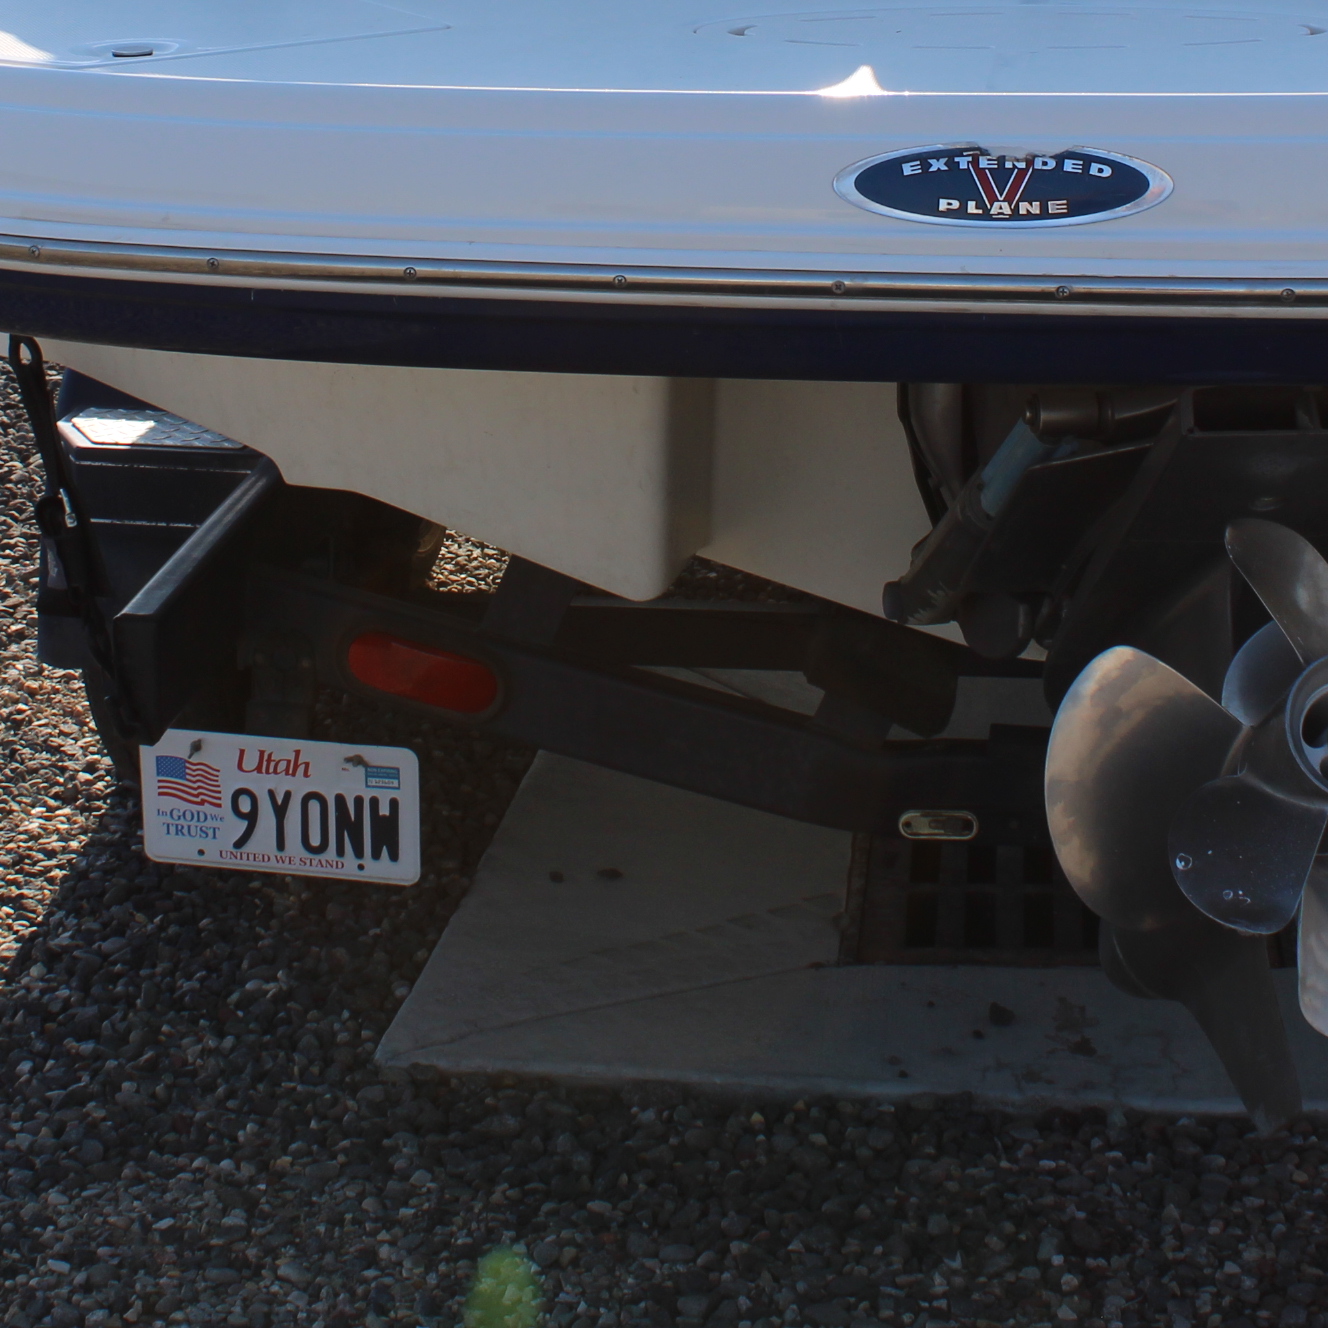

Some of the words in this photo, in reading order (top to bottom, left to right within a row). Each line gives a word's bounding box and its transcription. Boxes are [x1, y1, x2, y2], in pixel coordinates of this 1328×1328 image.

[901, 155, 1113, 179] EXTENDED
[938, 198, 1070, 216] PLANE
[236, 748, 312, 779] Utah
[156, 808, 168, 817] In
[169, 807, 209, 824] GOD
[209, 813, 225, 823] We
[162, 822, 221, 840] TRUST
[219, 849, 271, 864] UNITED
[274, 853, 297, 867] WE
[299, 856, 345, 870] STAND
